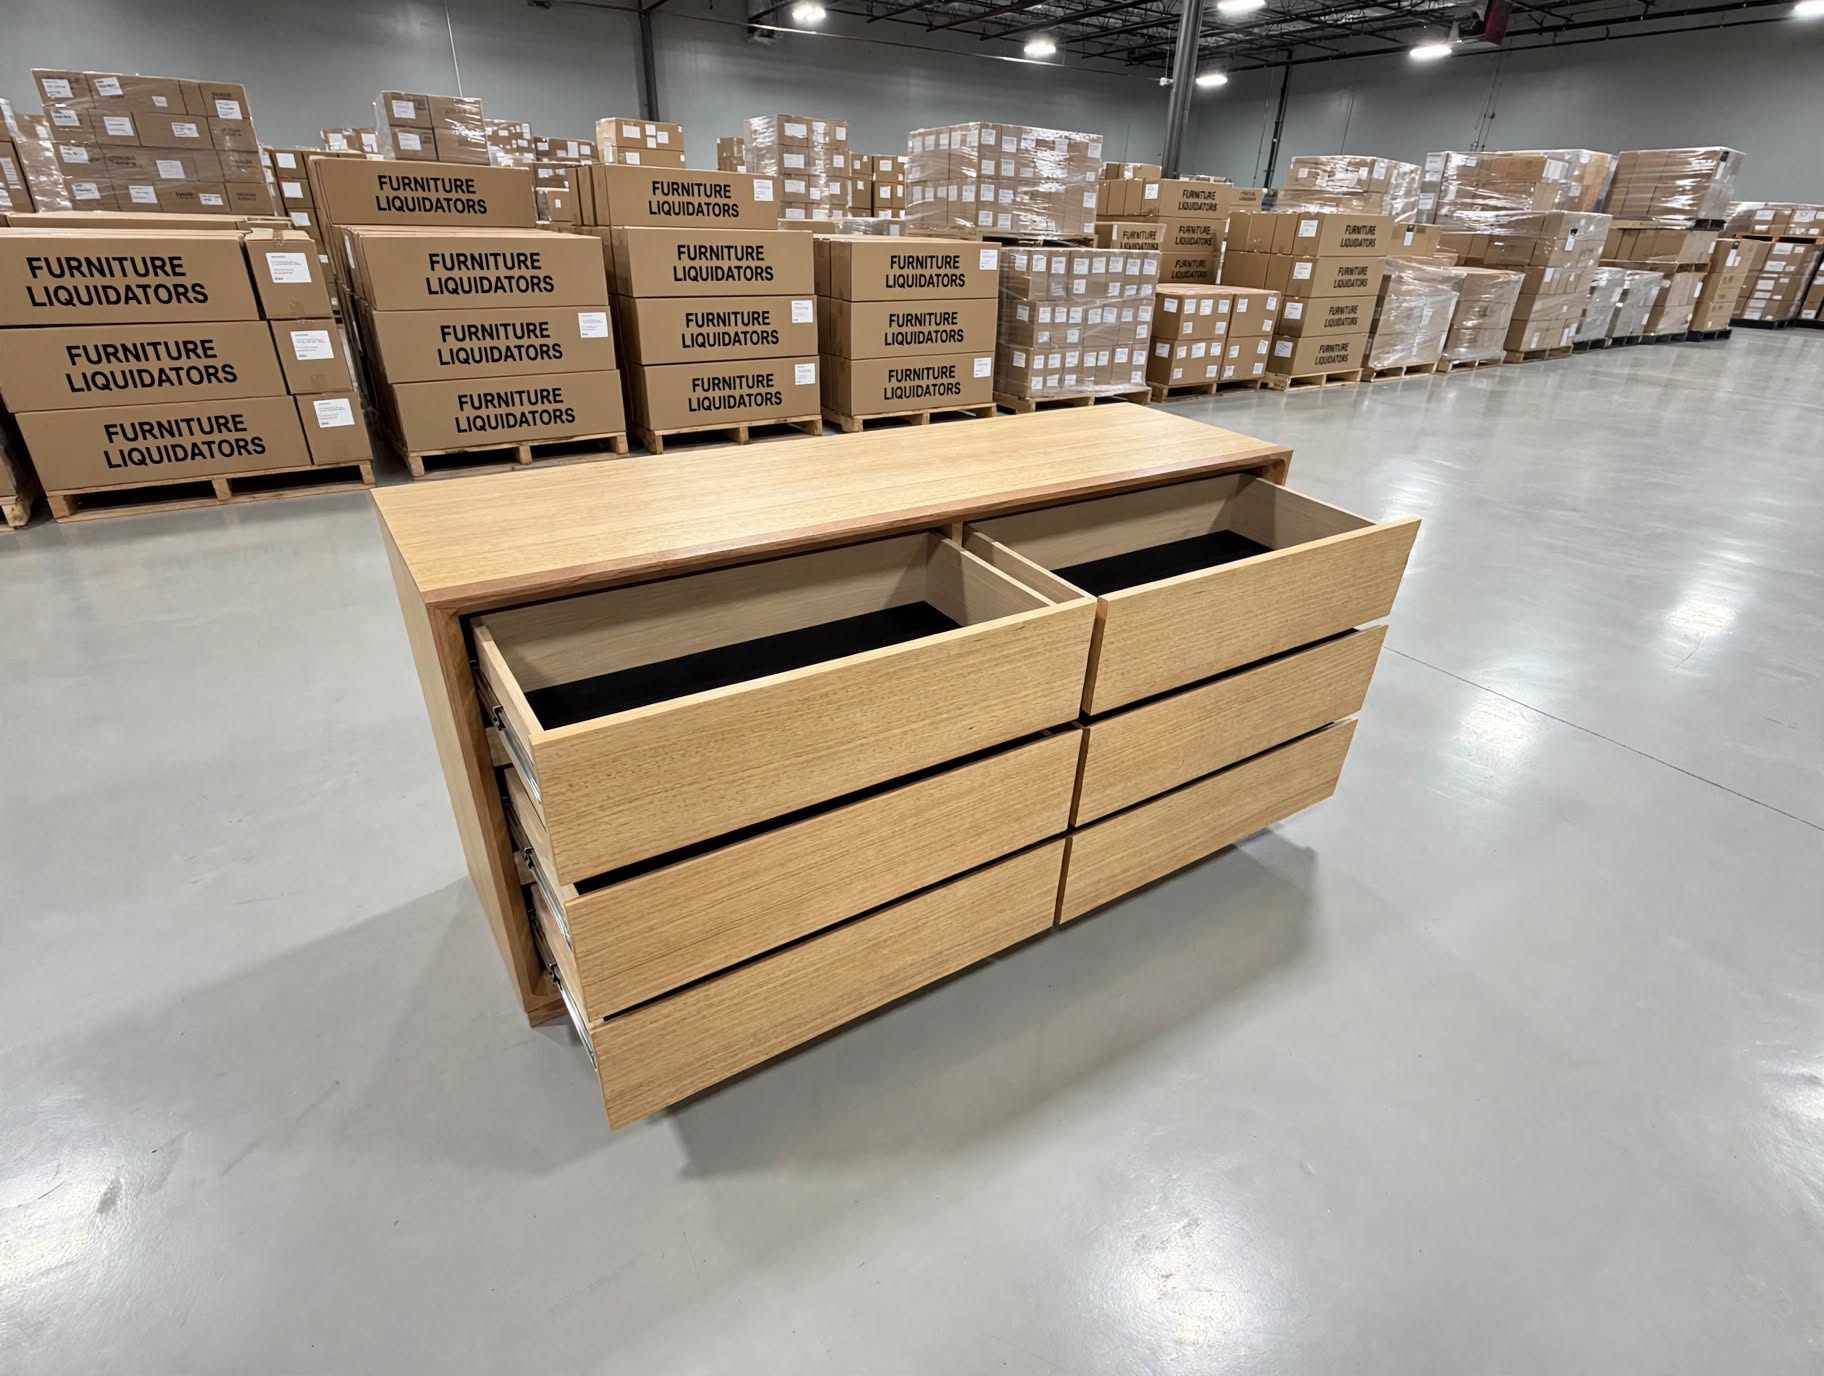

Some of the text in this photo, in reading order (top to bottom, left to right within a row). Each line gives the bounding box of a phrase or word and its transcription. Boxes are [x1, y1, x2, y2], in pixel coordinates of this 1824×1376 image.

[378, 175, 476, 194] FURNITURE
[652, 181, 731, 198] FURNITURE
[376, 196, 487, 214] LIQUIDATORS
[649, 200, 739, 217] LIQUIDATORS
[1344, 225, 1376, 236] FURNITURE
[1340, 238, 1376, 248] LIQUIDATORS
[429, 253, 541, 271] FURNITURE
[678, 245, 764, 261] FURNITURE
[891, 255, 960, 269] FURNITURE
[26, 256, 186, 278] FURNITURE
[674, 266, 773, 282] LIQUIDATORS
[1337, 266, 1369, 277] FURNITURE
[426, 275, 554, 295] LIQUIDATORS
[886, 274, 965, 288] LIQUIDATORS
[1333, 278, 1368, 289] LIQUIDATORS
[26, 283, 208, 307] LIQUIDATORS
[1328, 305, 1359, 315] FURNITURE
[686, 311, 770, 328] FURNITURE
[889, 312, 957, 327] FURNITURE
[1324, 317, 1359, 328] LIQUIDATORS
[440, 322, 550, 342] FURNITURE
[682, 330, 779, 348] LIQUIDATORS
[885, 329, 963, 345] LIQUIDATORS
[66, 340, 217, 366] FURNITURE
[438, 343, 562, 365] LIQUIDATORS
[1318, 342, 1350, 354] FURNITURE
[66, 364, 237, 392] LIQUIDATORS
[693, 374, 774, 392] FURNITURE
[889, 366, 955, 382] FURNITURE
[458, 388, 563, 411] FURNITURE
[884, 382, 960, 400] LIQUIDATORS
[689, 391, 782, 412] LIQUIDATORS
[104, 414, 247, 443] FURNITURE
[455, 408, 575, 433] LIQUIDATORS
[104, 437, 265, 468] LIQUIDATORS
